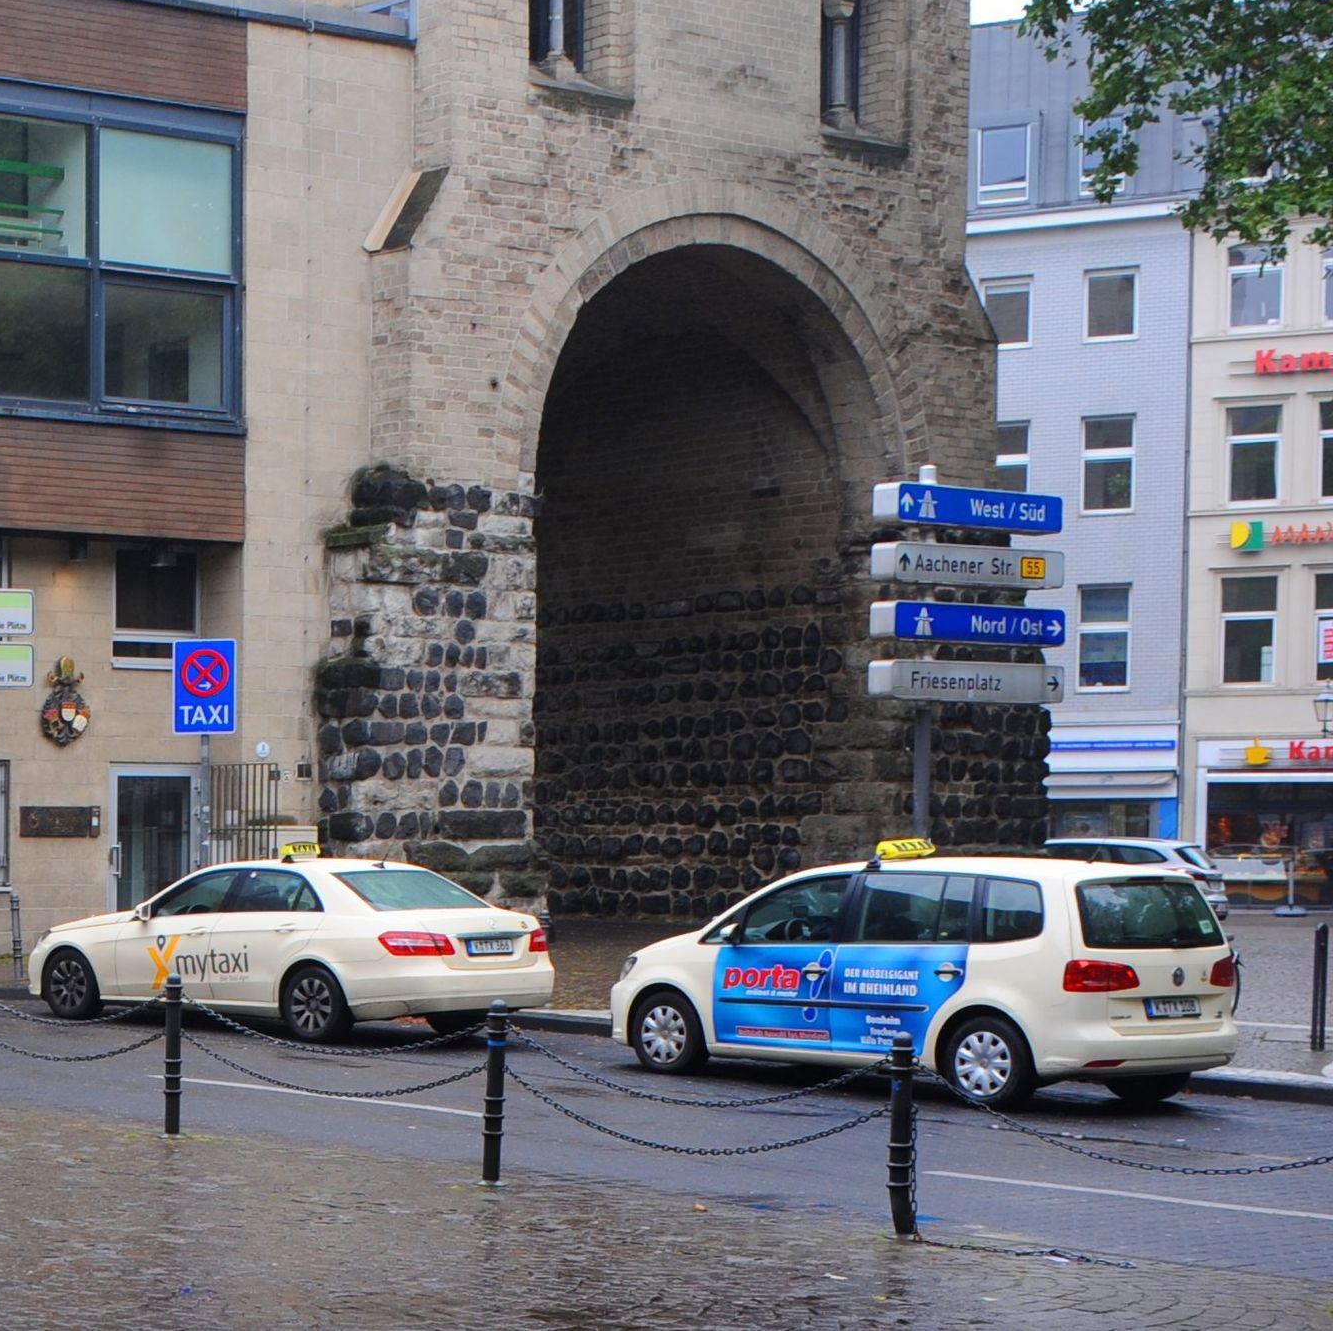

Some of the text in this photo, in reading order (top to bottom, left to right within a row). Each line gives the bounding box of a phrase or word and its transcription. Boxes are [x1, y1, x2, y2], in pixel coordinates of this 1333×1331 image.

[970, 498, 1004, 519] West
[1019, 503, 1046, 521] Süd
[915, 554, 1041, 576] Aachener Str. 55
[7, 621, 27, 630] Plätze
[971, 615, 1006, 634] Nord
[1020, 618, 1043, 636] Ost
[7, 674, 27, 683] Plätze
[910, 671, 1002, 692] Friesenplatz
[179, 704, 229, 725] TAXI
[1289, 741, 1333, 761] Ka
[175, 944, 249, 982] mytaxi
[844, 968, 860, 978] DER
[723, 964, 800, 990] porta
[844, 982, 918, 997] IM RHEINLAND
